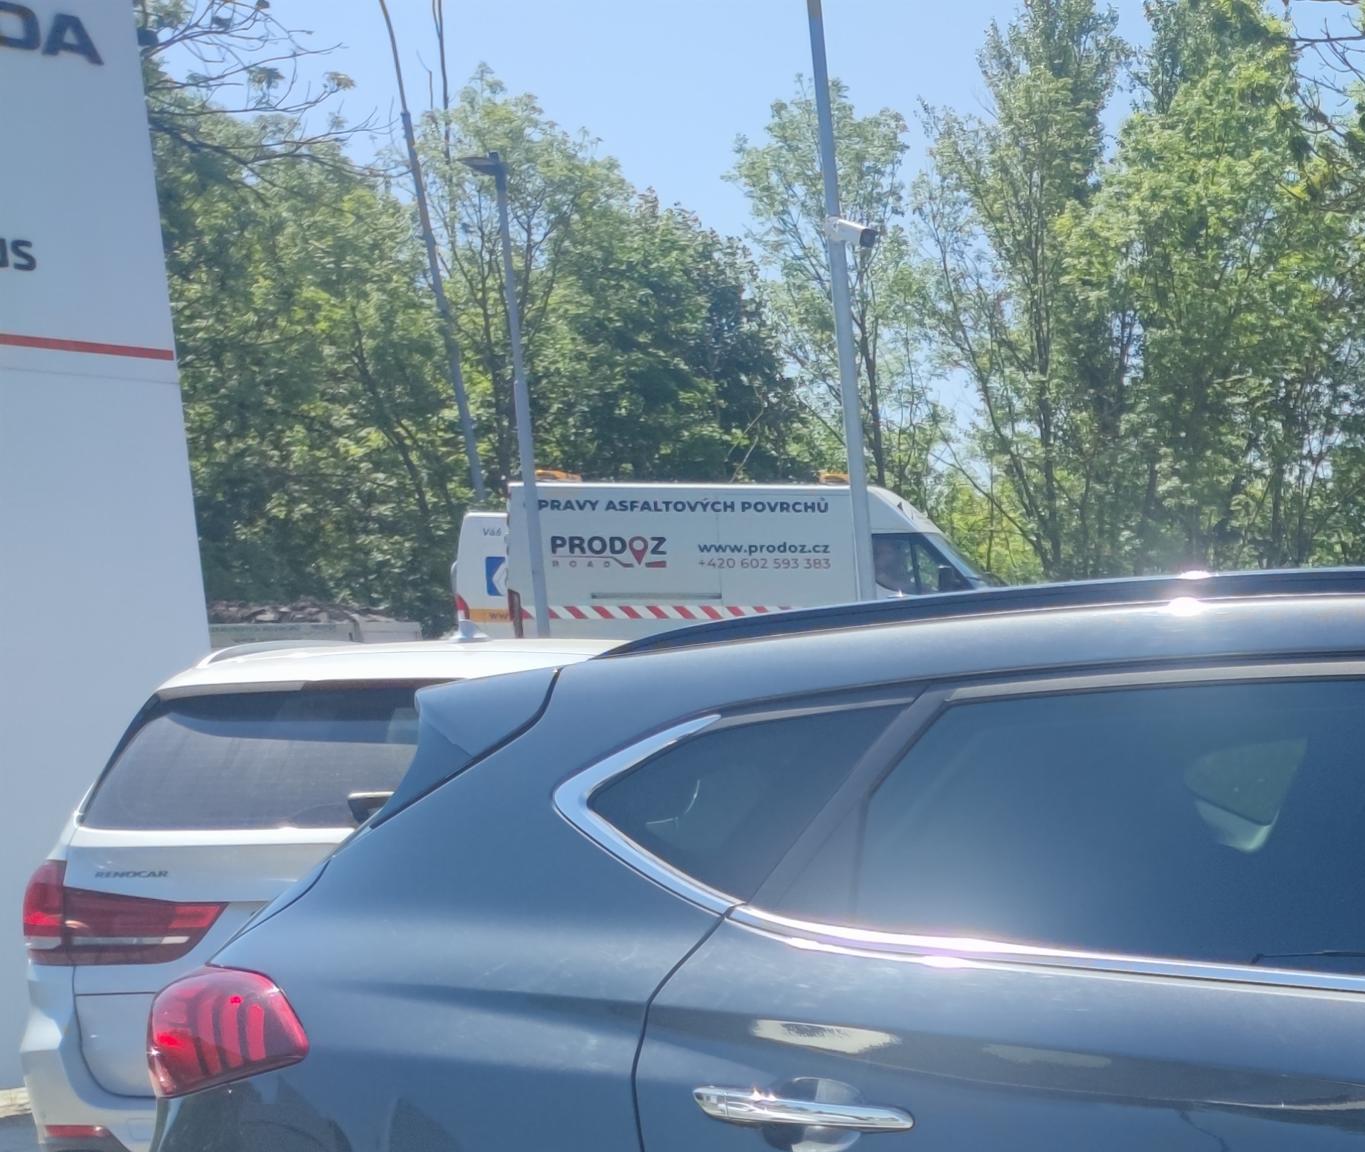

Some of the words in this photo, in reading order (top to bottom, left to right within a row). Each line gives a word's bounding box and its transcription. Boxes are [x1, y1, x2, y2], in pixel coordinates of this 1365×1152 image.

[523, 499, 599, 512] PRAVY
[605, 498, 735, 513] ASFALTOVÝCH
[741, 497, 829, 513] POVRCHŮ
[551, 536, 667, 560] PRODOZ
[698, 541, 831, 557] www.prodoz.cz
[698, 557, 736, 569] +420
[741, 557, 769, 569] 602
[773, 558, 800, 570] 593
[804, 558, 831, 570] 383
